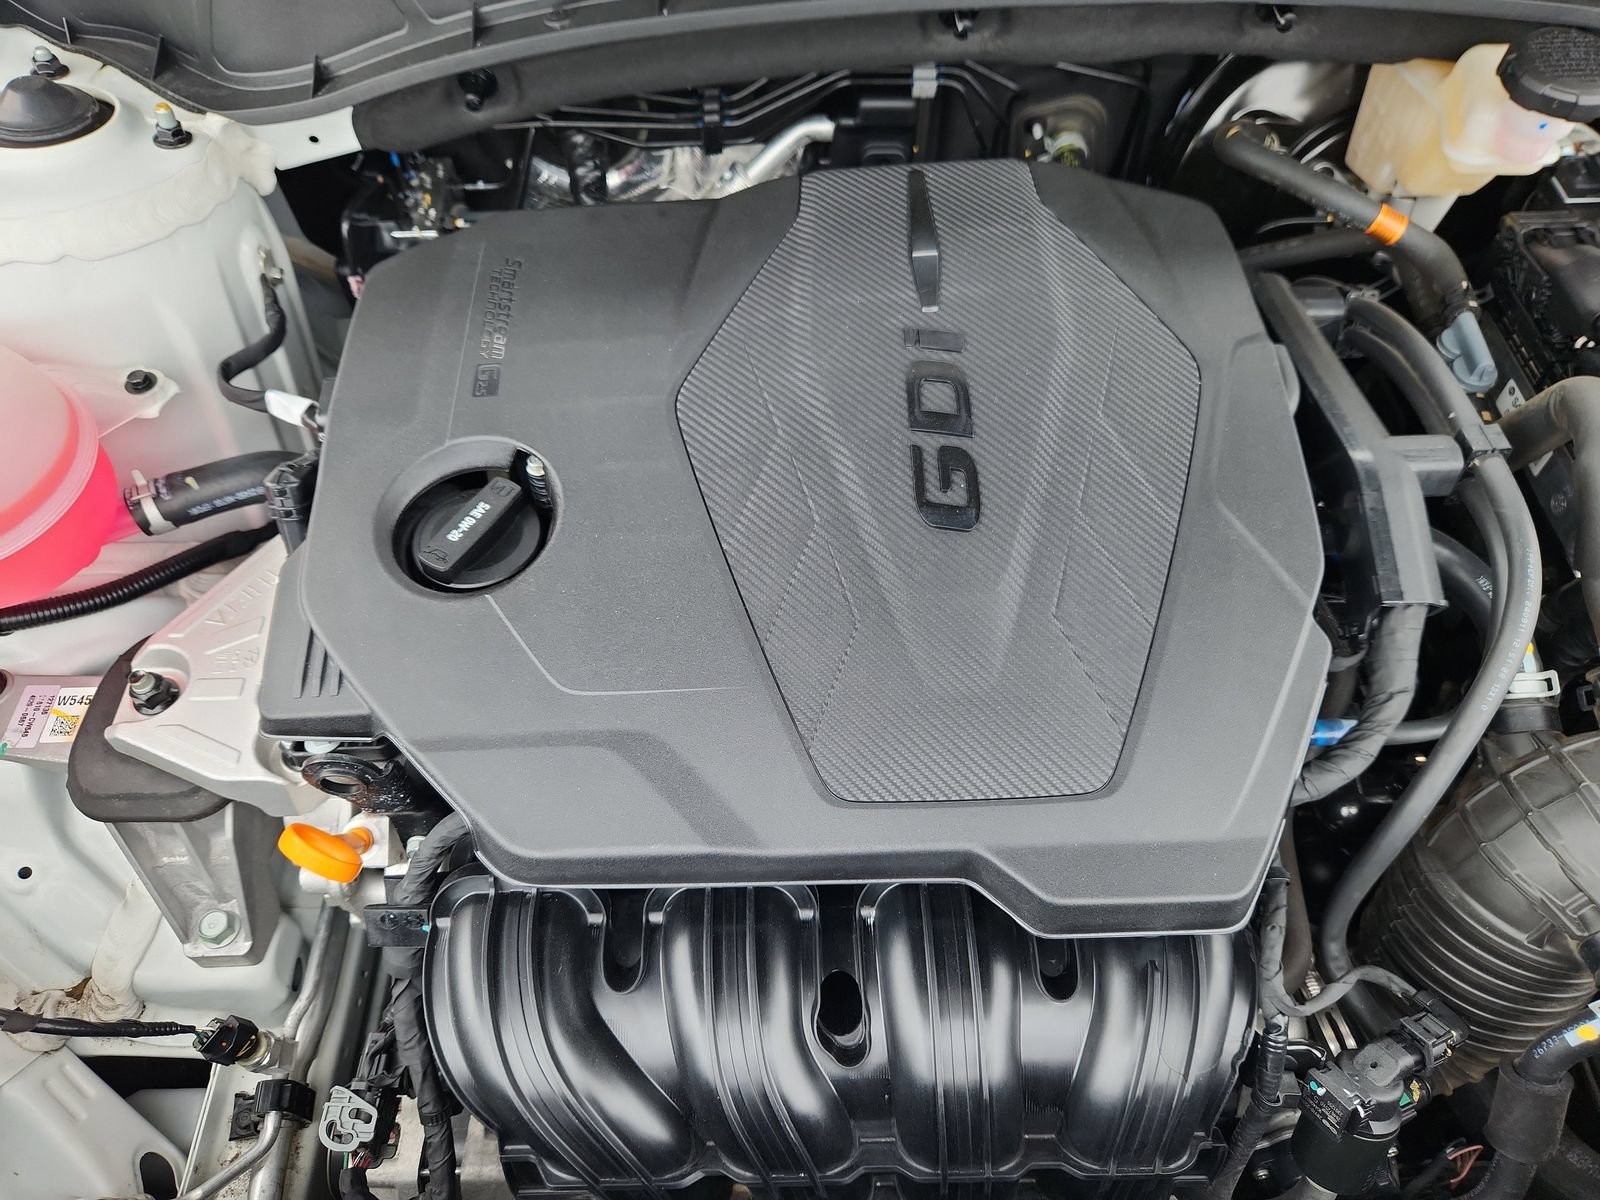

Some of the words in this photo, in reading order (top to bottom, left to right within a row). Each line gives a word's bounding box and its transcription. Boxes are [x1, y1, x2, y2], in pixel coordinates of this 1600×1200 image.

[480, 268, 502, 359] TECHNOLOGY
[490, 258, 522, 360] Smartstream
[469, 501, 491, 519] SAE
[446, 515, 477, 542] 0W-20
[57, 694, 93, 706] W545
[1532, 1020, 1590, 1059] 26733-
